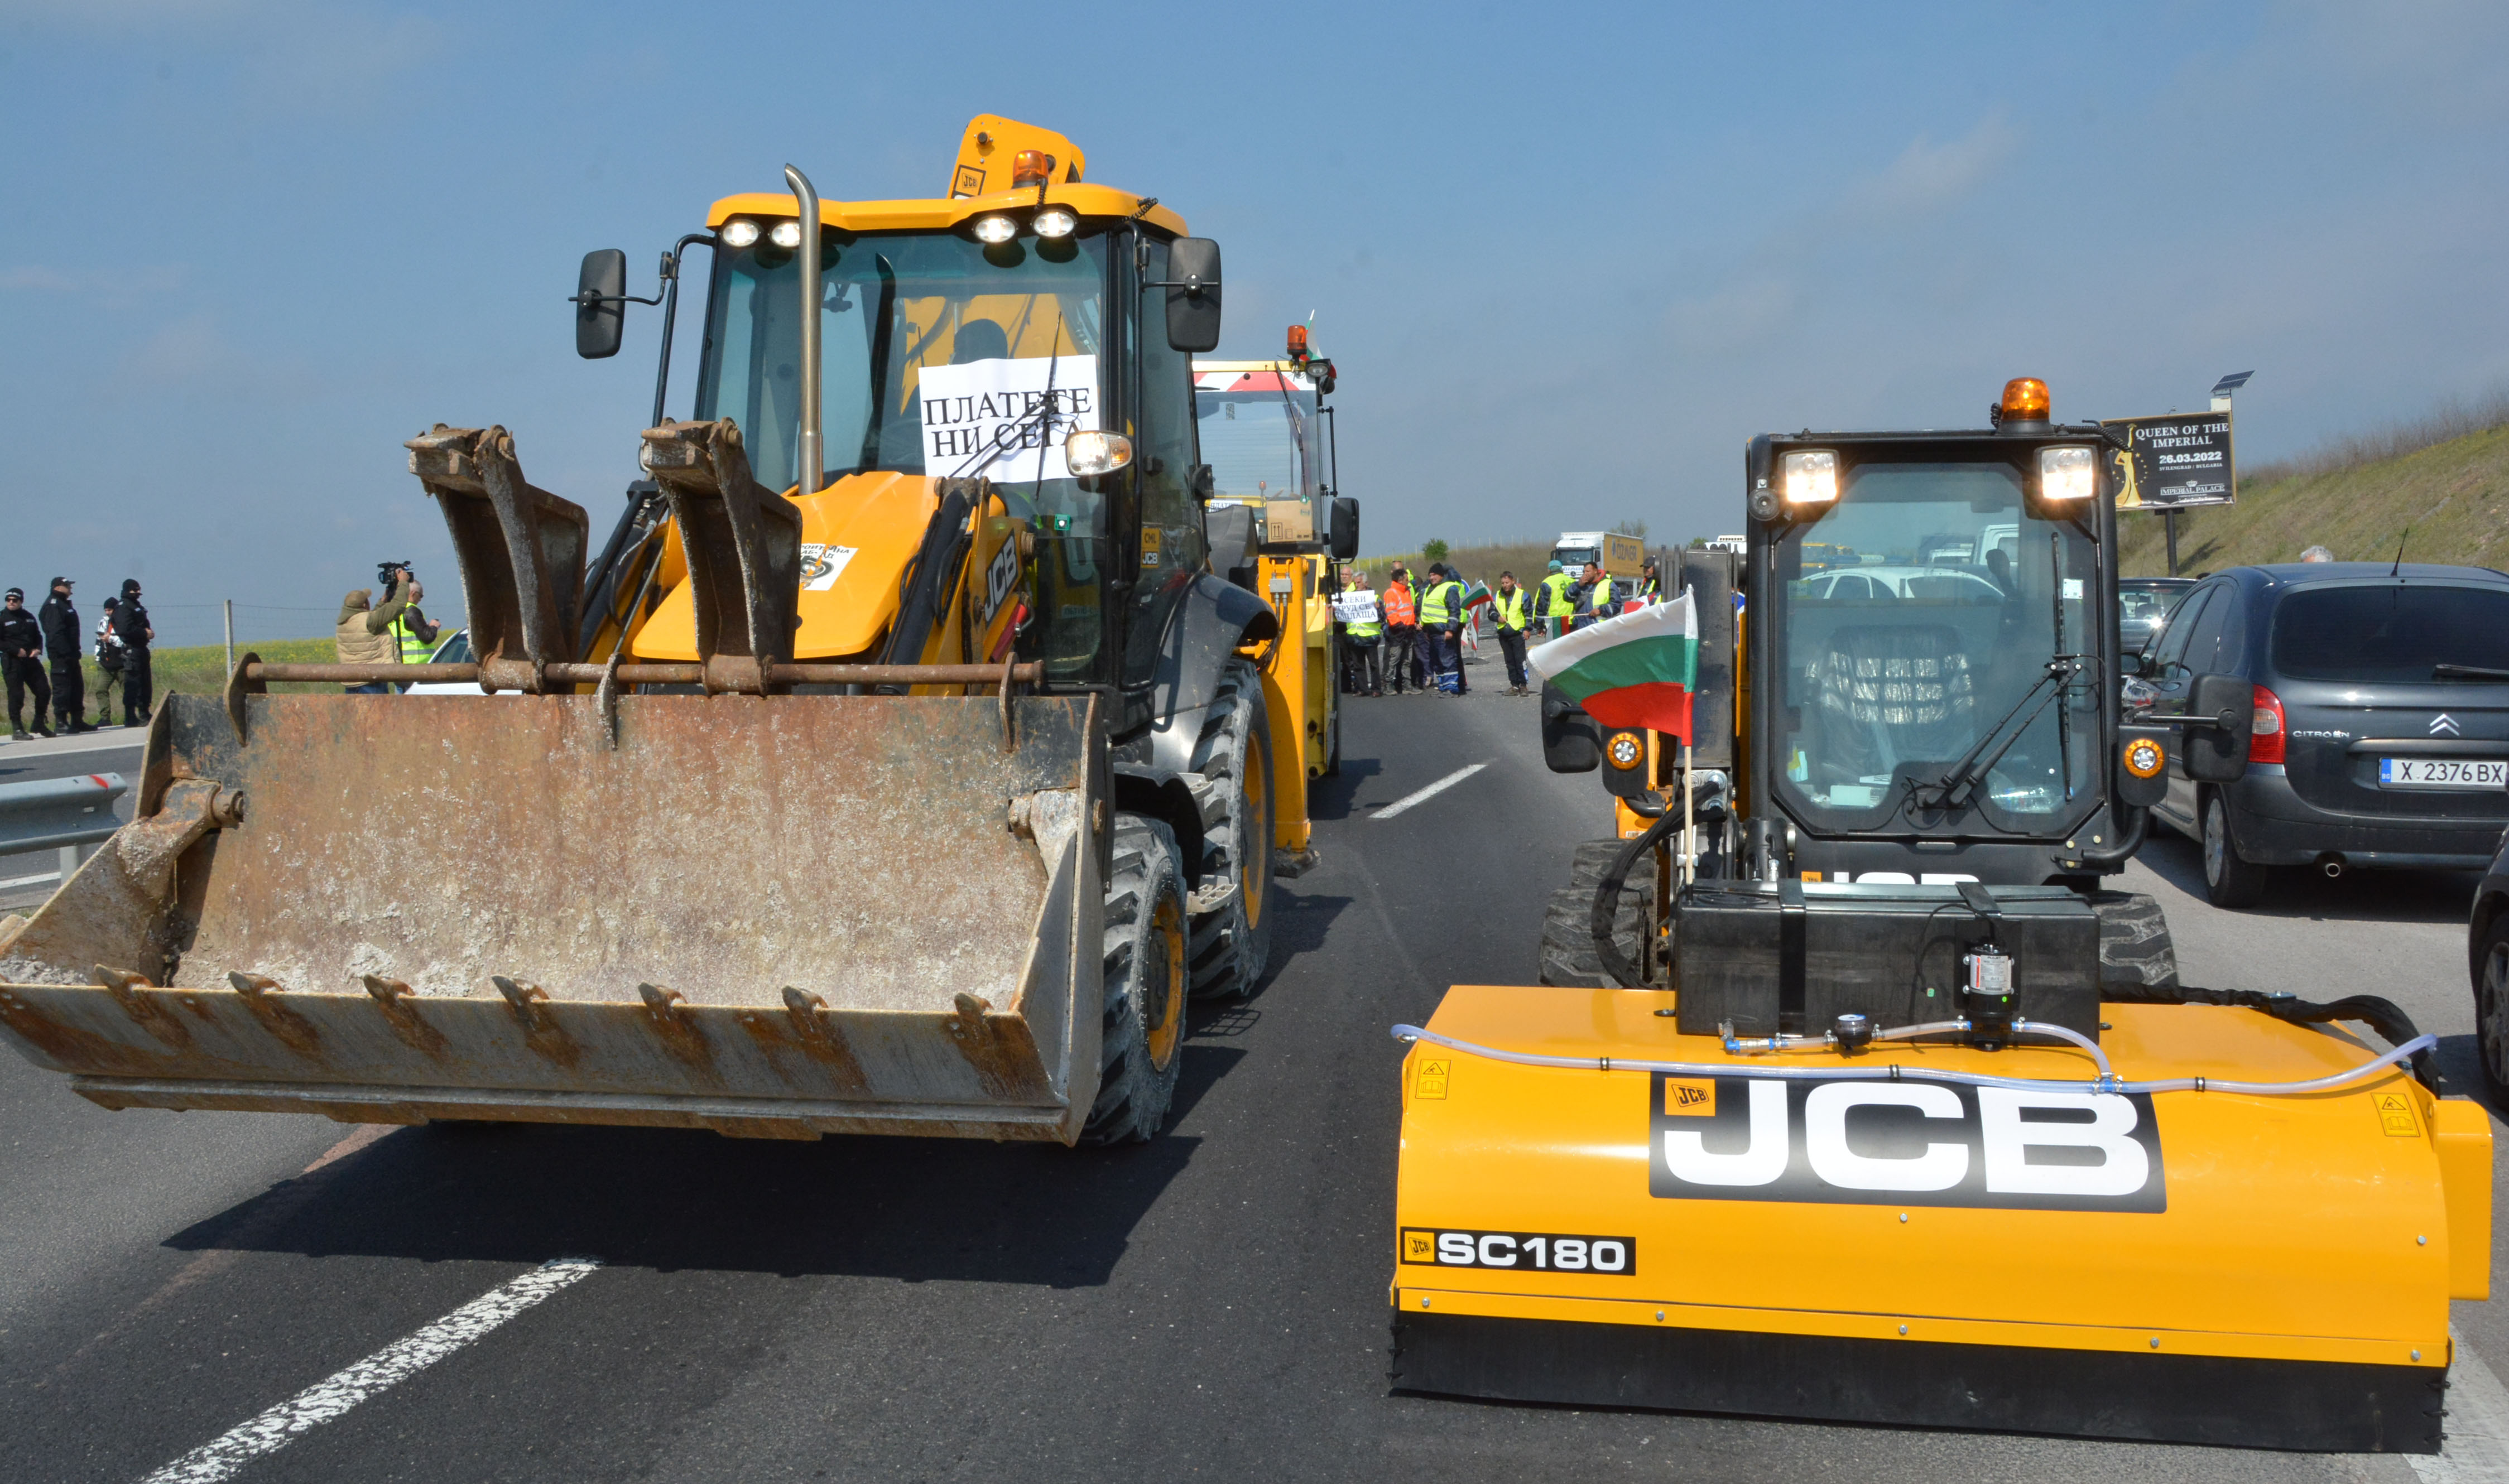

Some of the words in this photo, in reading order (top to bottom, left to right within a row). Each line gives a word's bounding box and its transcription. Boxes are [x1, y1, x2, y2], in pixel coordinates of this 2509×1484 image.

[963, 175, 978, 187] JCB
[923, 388, 1092, 425] ПЛАТЕТЕ
[2135, 426, 2179, 441] QUEEN
[2183, 425, 2199, 435] OF
[2203, 422, 2229, 433] THE
[931, 426, 983, 457] НИ
[2152, 435, 2213, 449] IMPERIAL
[2159, 451, 2223, 465] 26.03.2022
[2160, 487, 2195, 495] IMPERIAL
[2196, 485, 2226, 493] PALACE
[1144, 532, 1157, 544] CML
[1142, 552, 1158, 564] JCB
[984, 535, 1017, 621] JCB
[1336, 610, 1376, 620] ЗАПЛАЩА
[2401, 762, 2413, 780] X
[2424, 763, 2473, 782] 2376
[2477, 764, 2503, 783] BX
[1678, 1087, 1707, 1104] JCB
[1664, 1080, 2149, 1196] JCB
[1413, 1239, 1430, 1253] JCB
[1438, 1233, 1626, 1271] SC180
